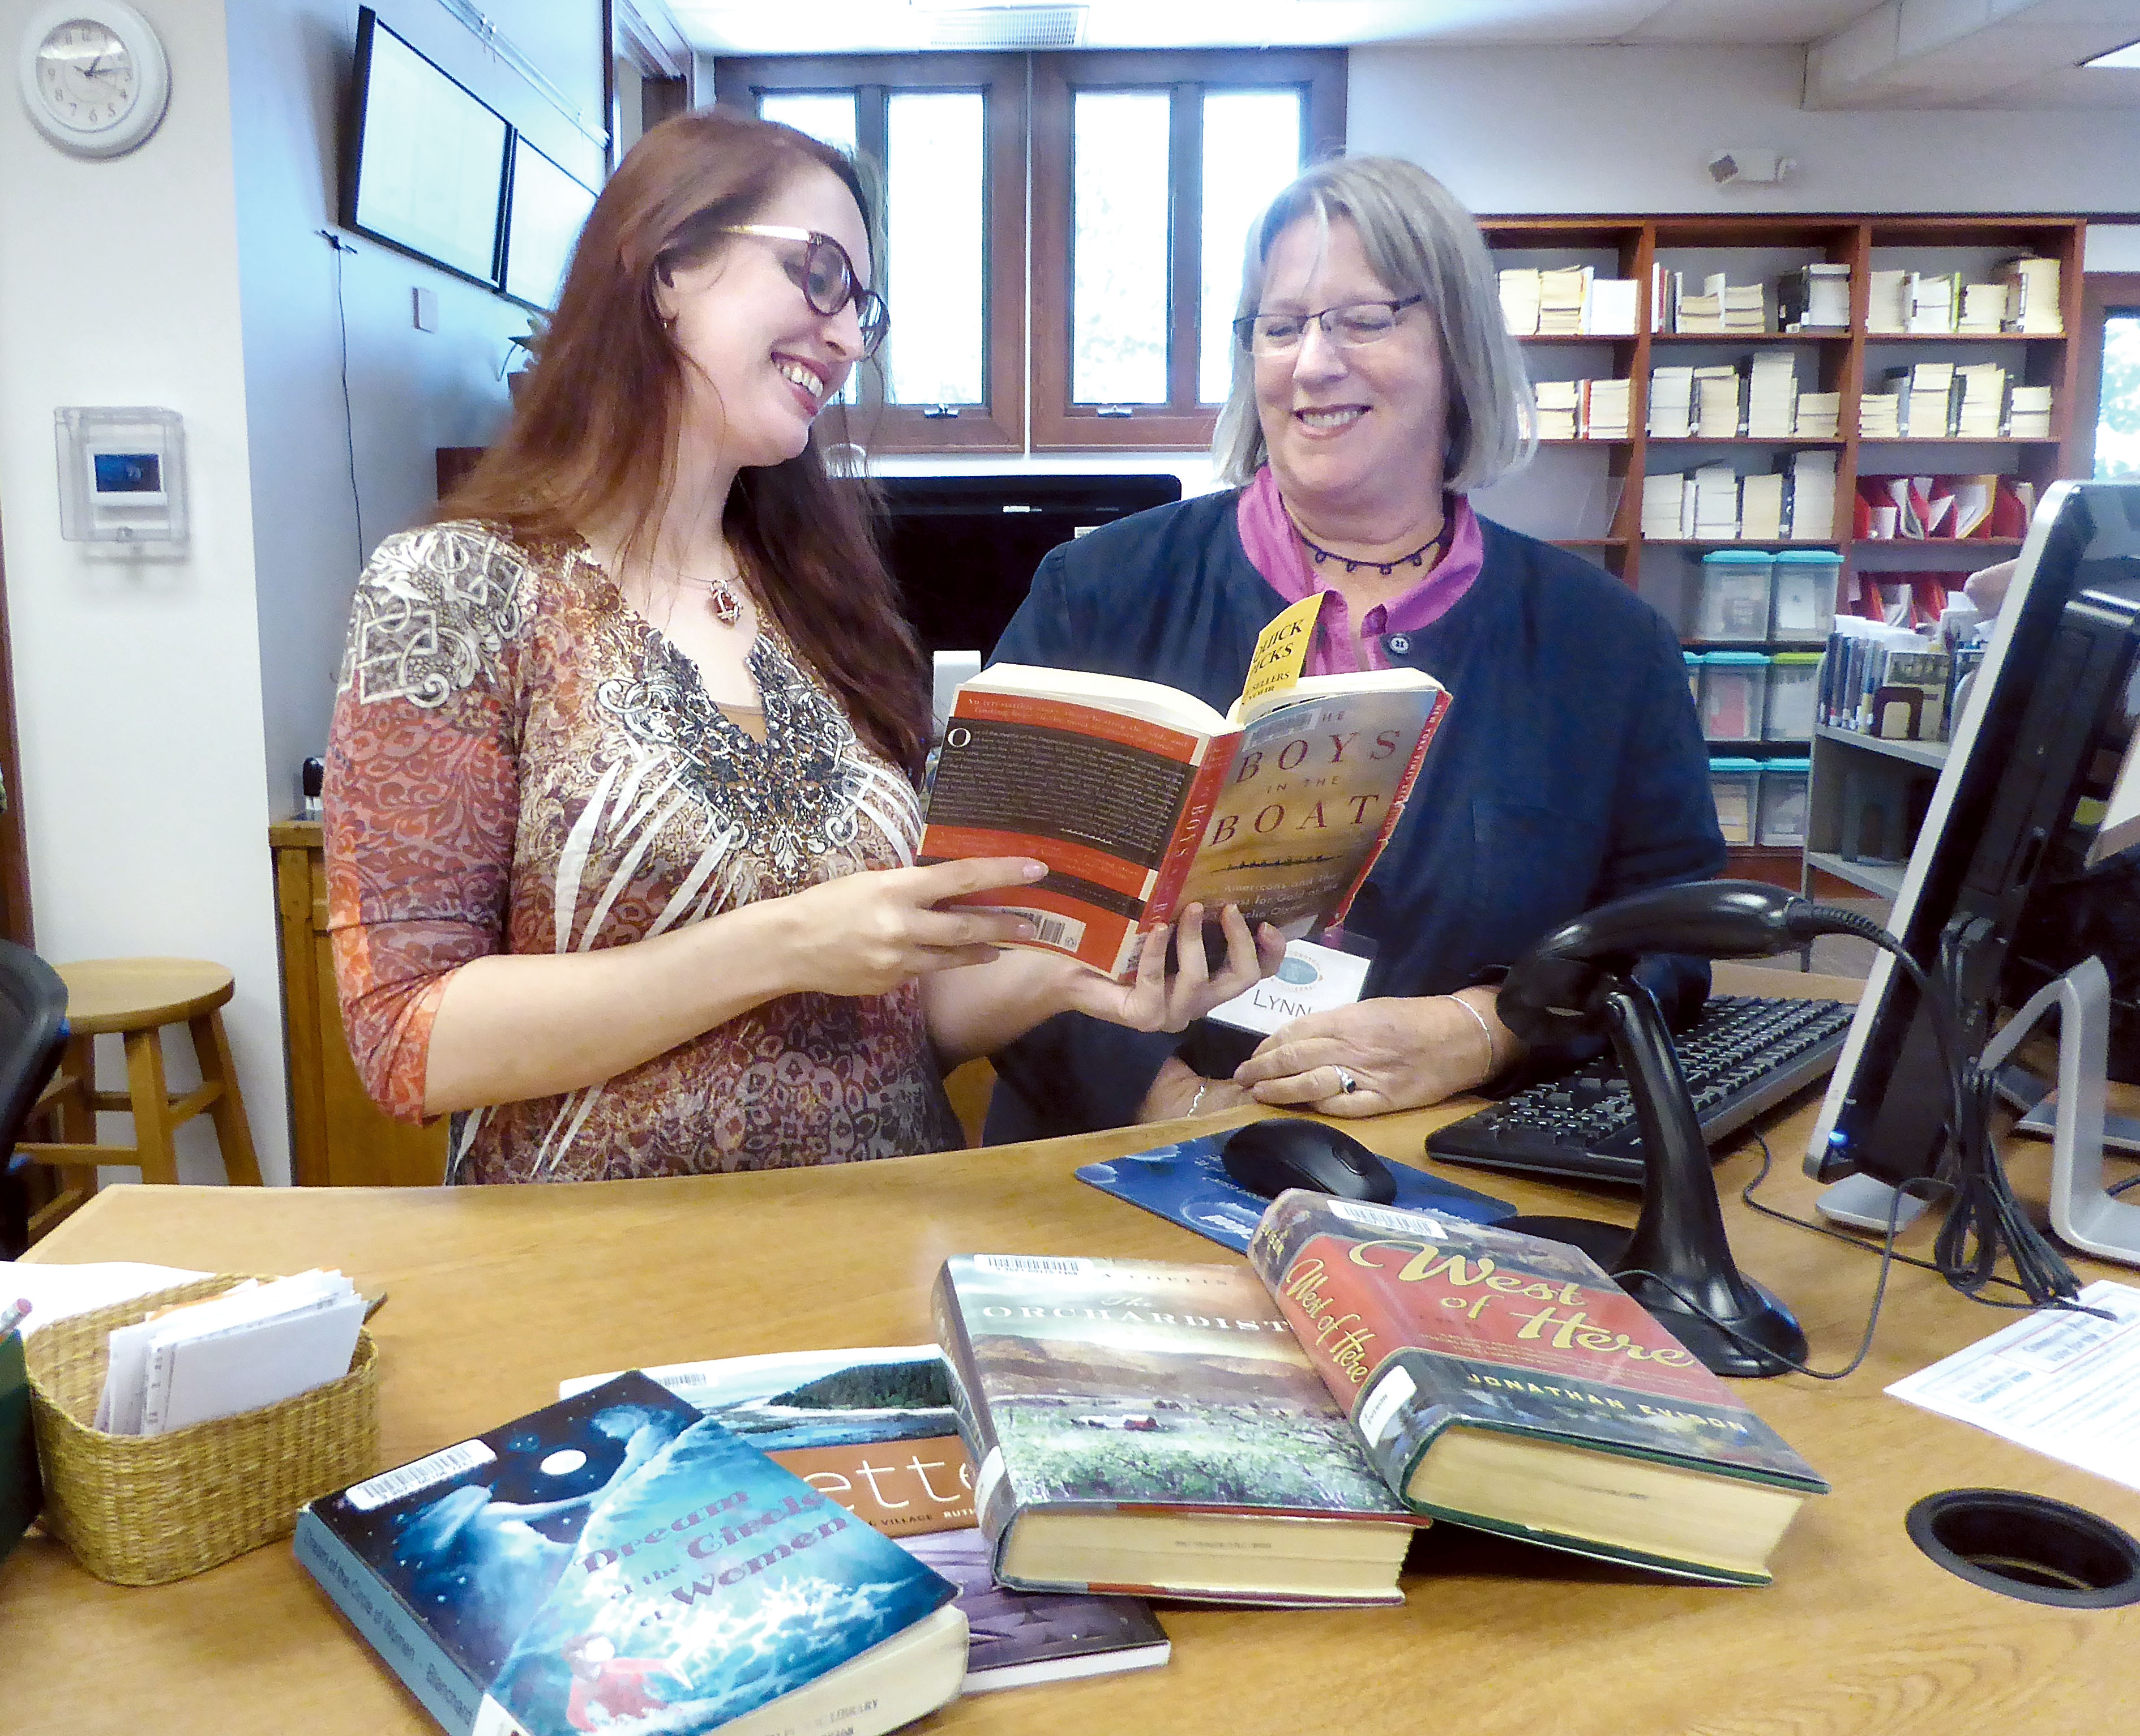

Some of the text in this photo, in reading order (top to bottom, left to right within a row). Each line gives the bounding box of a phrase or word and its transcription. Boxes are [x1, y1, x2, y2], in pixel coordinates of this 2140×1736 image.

[1322, 711, 1345, 722] HE
[1236, 730, 1400, 784] BOYS
[1267, 775, 1339, 794] IN THE
[1209, 794, 1380, 847] BOAT
[1255, 895, 1271, 905] for
[1253, 989, 1312, 1017] LYNN
[1348, 1239, 1588, 1307] West
[982, 1305, 1291, 1333] ORCHARDIST
[1285, 1258, 1377, 1384] West of Here
[1440, 1294, 1505, 1319] of
[1509, 1306, 1695, 1368] Here
[1469, 1372, 1627, 1410] JONATHAN
[573, 1491, 750, 1574] Dream
[687, 1490, 828, 1560] Circle
[880, 1513, 933, 1527] VILLAGE
[665, 1517, 849, 1606] Women
